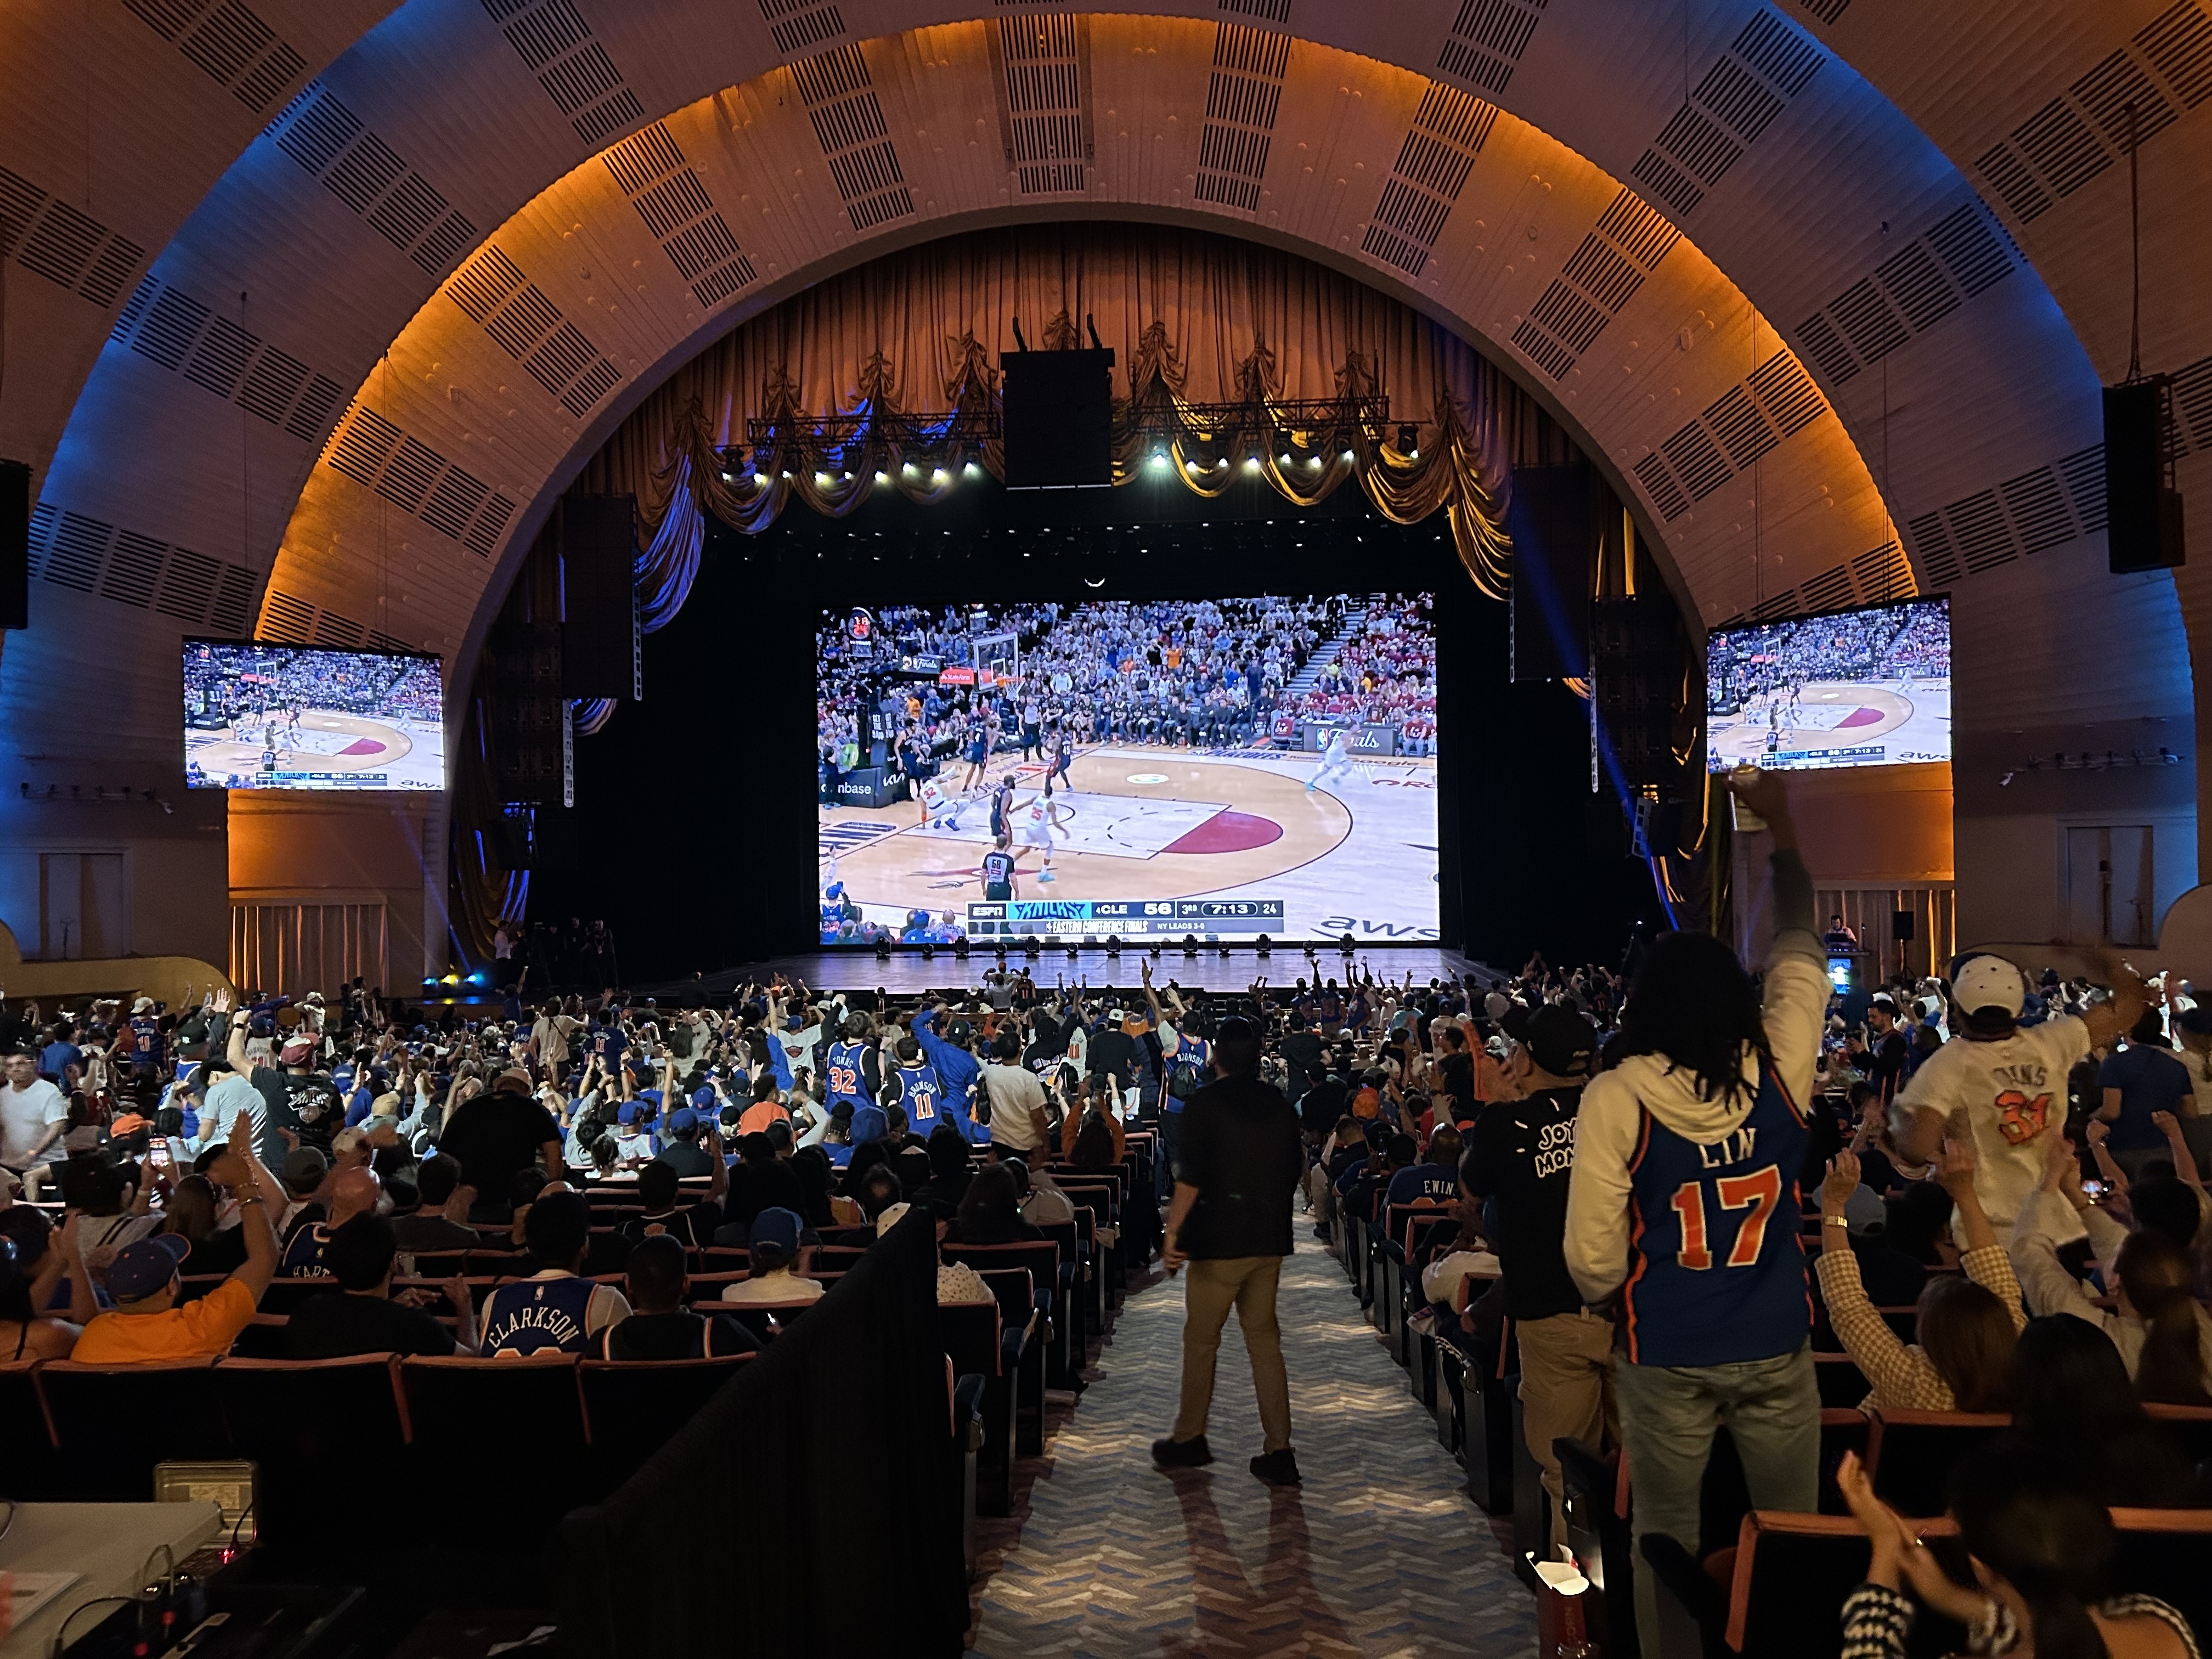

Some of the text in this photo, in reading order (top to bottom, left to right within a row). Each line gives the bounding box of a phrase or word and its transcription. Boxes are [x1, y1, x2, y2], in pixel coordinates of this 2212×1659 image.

[1327, 728, 1380, 748] Fals
[821, 782, 872, 795] cnbase
[972, 906, 1003, 916] ESPN
[1101, 902, 1172, 915] CLE 56
[1182, 904, 1277, 915] 3RD 7:13 24
[1052, 920, 1148, 934] EASTERN CONFERENCE FINALS
[1321, 916, 1440, 939] aws
[832, 1056, 854, 1068] TOWNS
[829, 1066, 856, 1094] 32
[908, 1081, 937, 1098] BRUNSON
[915, 1092, 934, 1120] 11
[1538, 1117, 1577, 1150] JOY
[1699, 1127, 1758, 1169] LIN
[1423, 1180, 1456, 1196] EWIN
[1670, 1163, 1782, 1271] 17
[293, 1265, 330, 1278] HART
[488, 1306, 580, 1348] CLARKSON
